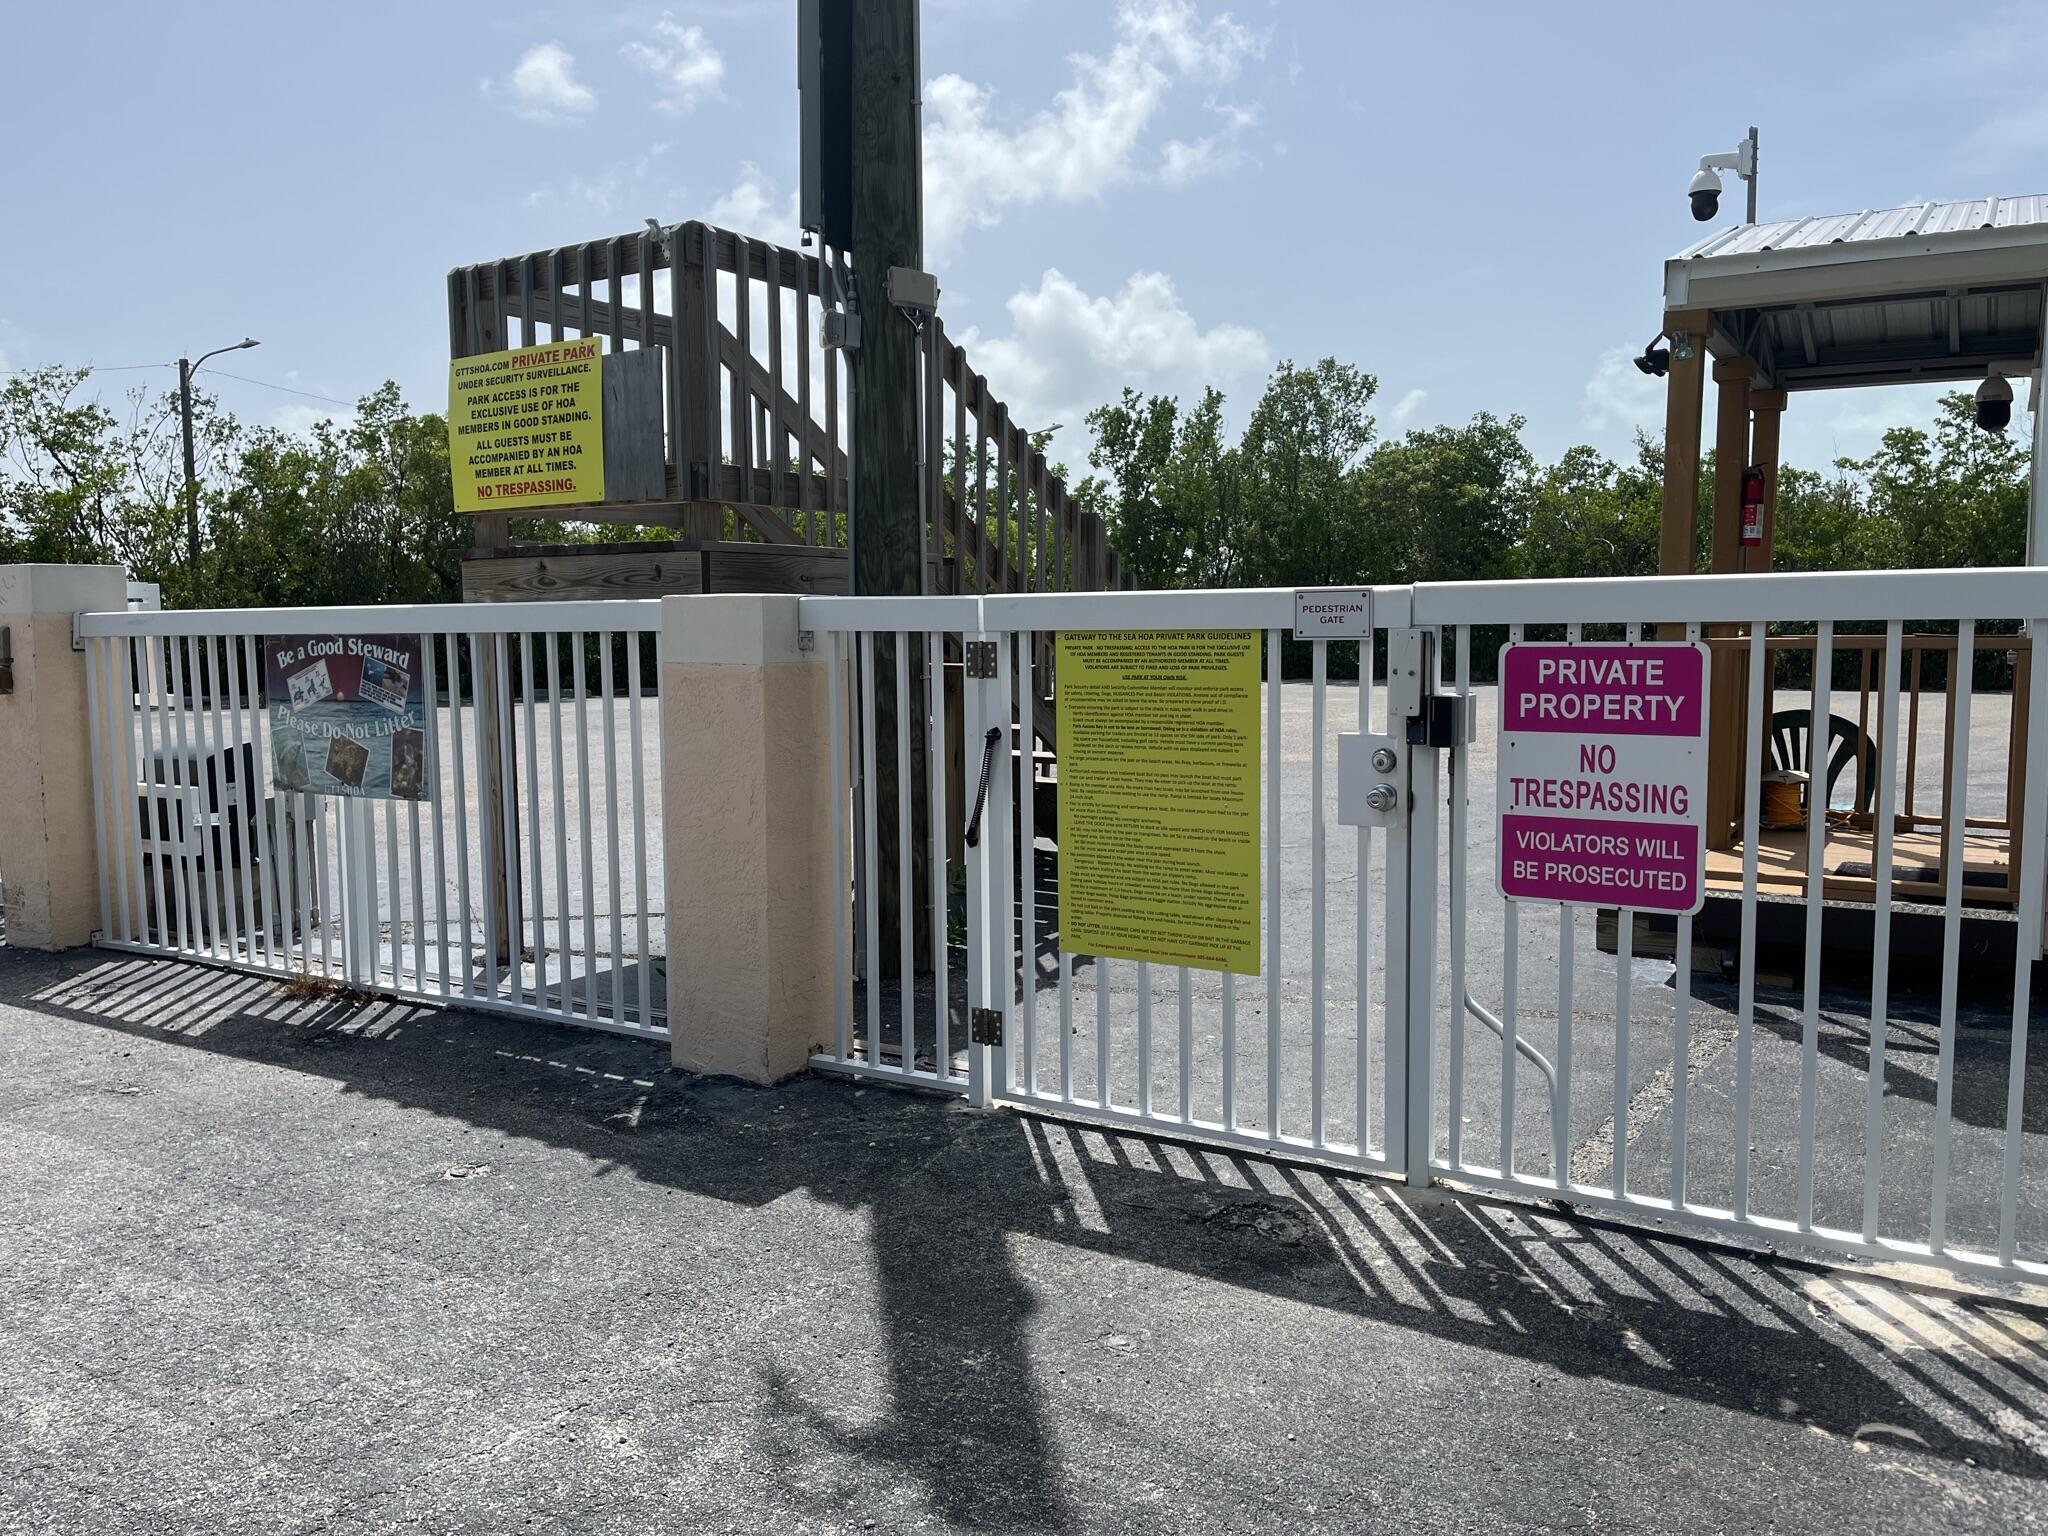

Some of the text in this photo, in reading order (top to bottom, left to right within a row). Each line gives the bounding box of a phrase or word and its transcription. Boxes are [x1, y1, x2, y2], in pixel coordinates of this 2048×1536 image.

[456, 344, 595, 376] GTTSHOA.COM PRIVATE PARK
[458, 364, 591, 390] UNDER SECURITY SURVEILLANCE.
[468, 382, 580, 405] PARK ACCESS IS FOR THE
[472, 398, 575, 419] EXCLUSIVE USE OF HOA
[458, 411, 591, 435] MEMBERS IN GOOD STANDING.
[477, 431, 572, 450] ALL GUESTS MUST BE
[469, 445, 582, 465] ACCOMPANIED BY AN HOA
[475, 460, 576, 478] MEMBER AT ALL TIMES.
[477, 478, 576, 497] NO TRESPASSING.
[1303, 604, 1362, 613] PEDESTRIAN
[276, 638, 410, 669] Be a Good Steward
[1538, 660, 1664, 685] PRIVATE
[1520, 693, 1685, 721] PROPERTY
[278, 704, 415, 739] Please Do Not Litter
[1580, 744, 1616, 774] NO
[1510, 778, 1688, 815] TRESPASSING
[1516, 830, 1684, 859] VIOLATORS WILL
[1513, 861, 1686, 892] BE PROSECUTED
